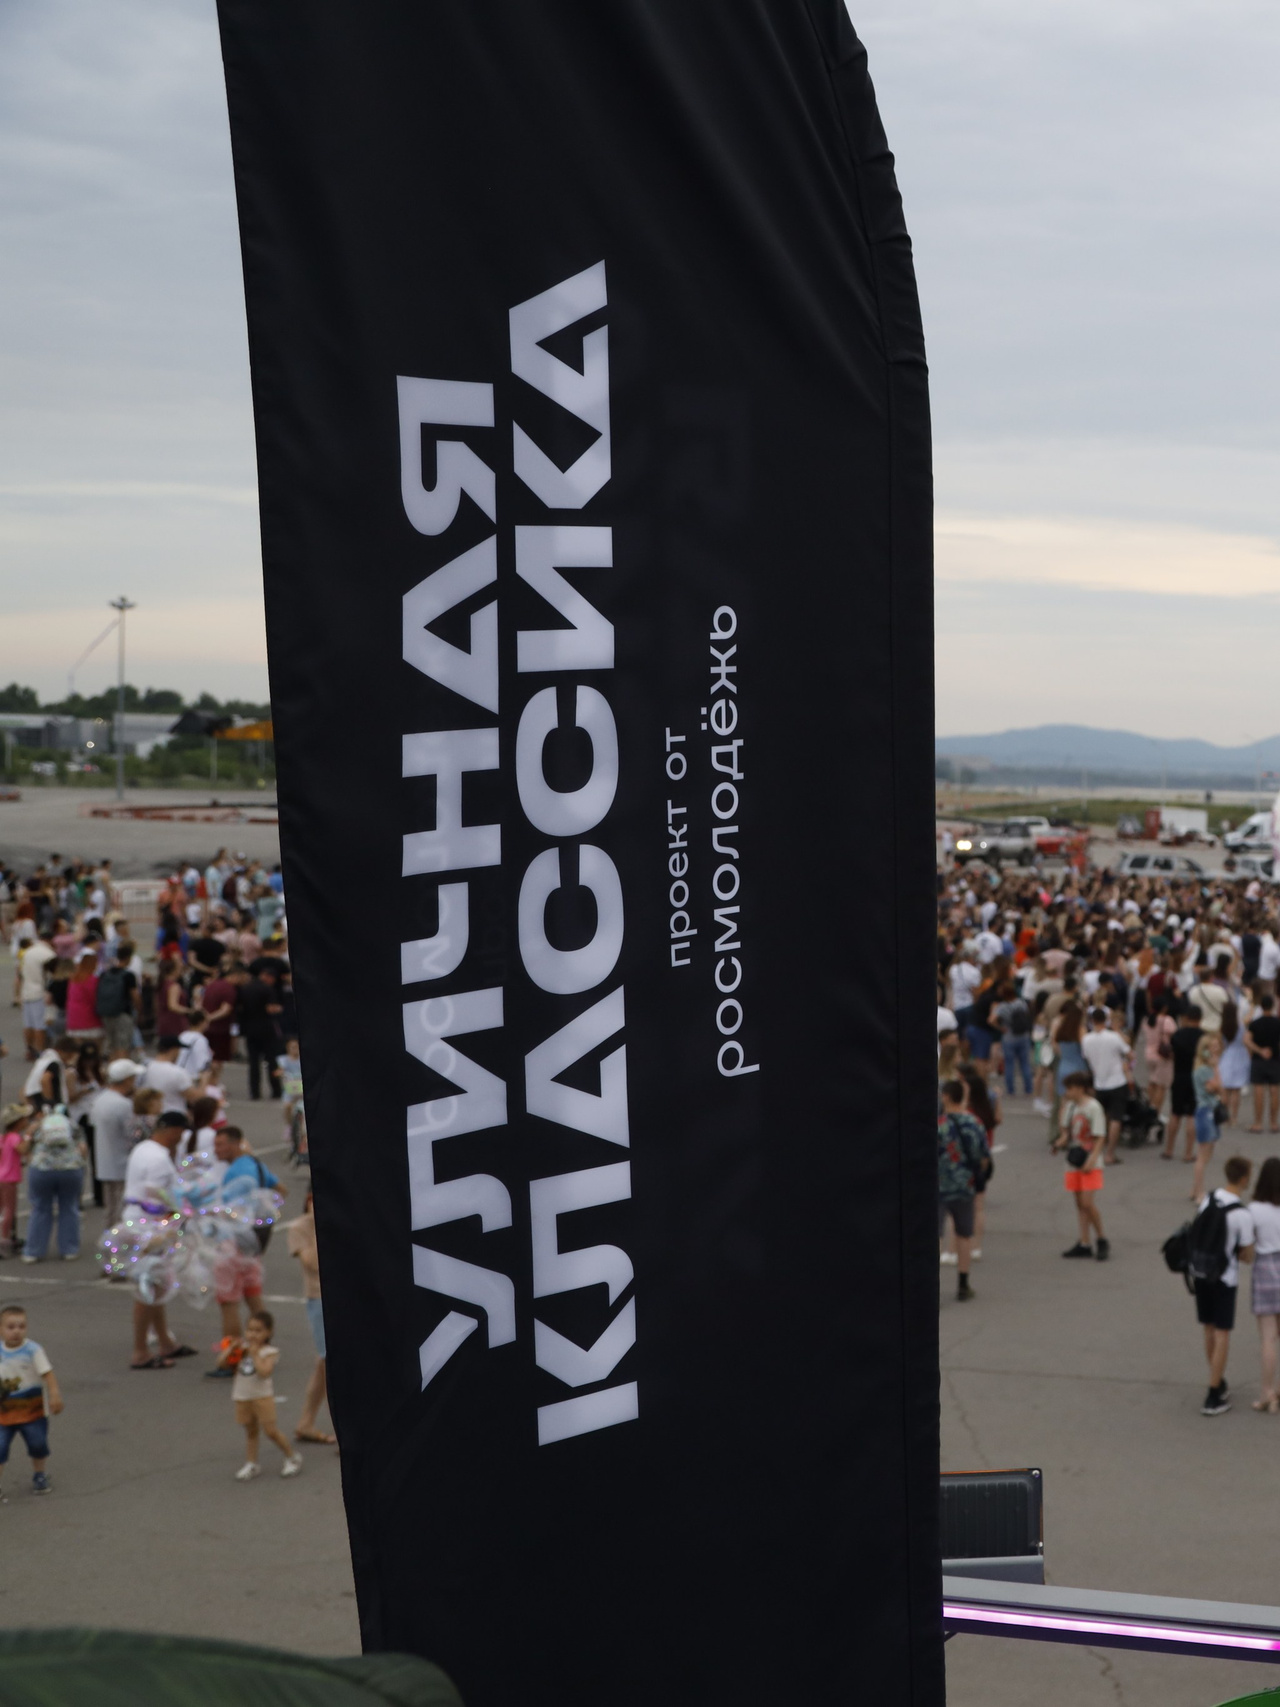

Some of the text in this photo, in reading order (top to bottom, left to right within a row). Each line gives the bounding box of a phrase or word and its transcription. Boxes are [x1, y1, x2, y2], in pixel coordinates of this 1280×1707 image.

[396, 374, 516, 1392] УЛИЧНАЯ
[509, 259, 639, 1446] КЛАССИКА
[665, 726, 698, 967] проект от
[701, 605, 761, 1077] росмолодёжь
